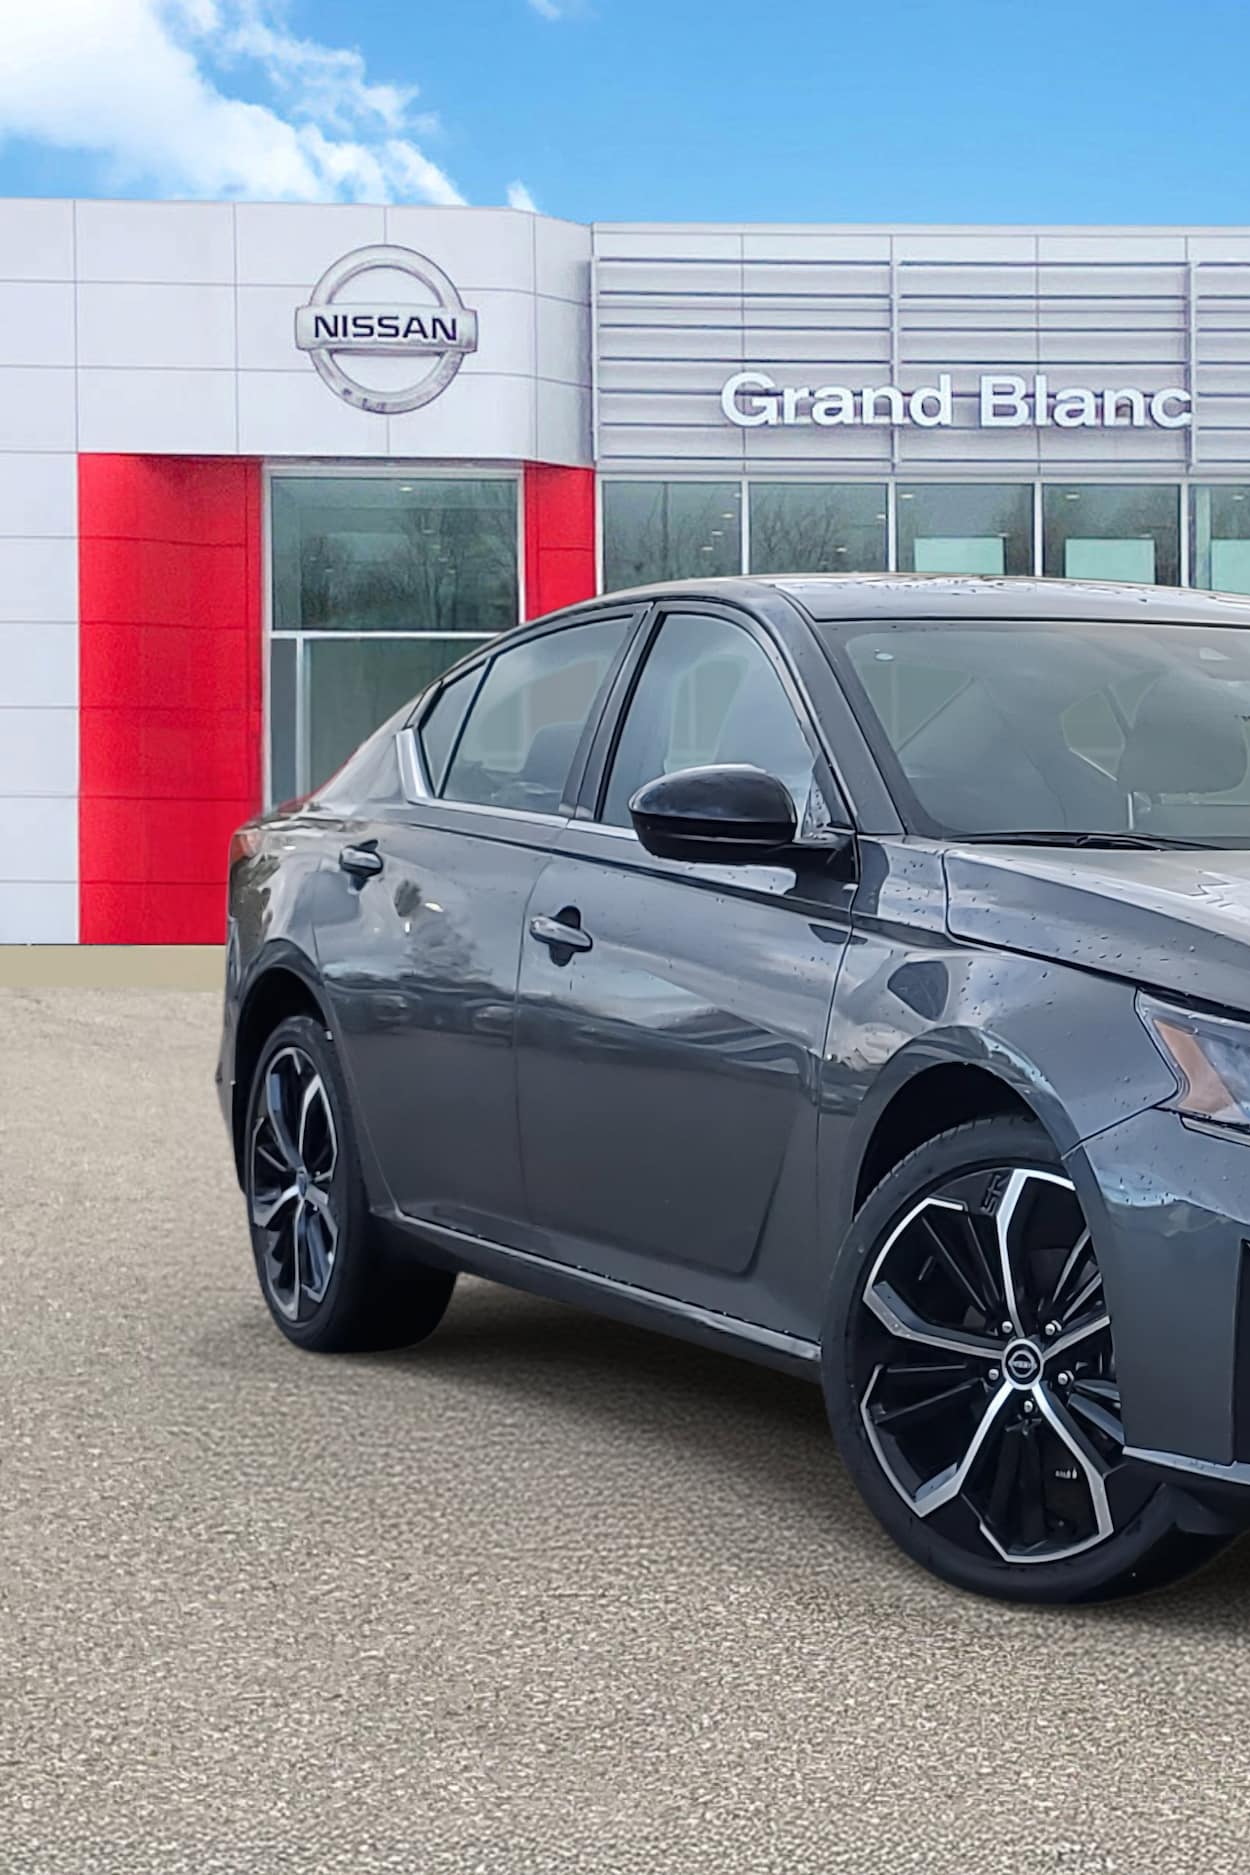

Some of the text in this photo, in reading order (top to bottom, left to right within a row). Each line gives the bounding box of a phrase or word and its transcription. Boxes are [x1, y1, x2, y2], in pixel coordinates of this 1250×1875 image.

[314, 315, 457, 341] NISSAN
[720, 371, 1193, 429] Grand Blanc
